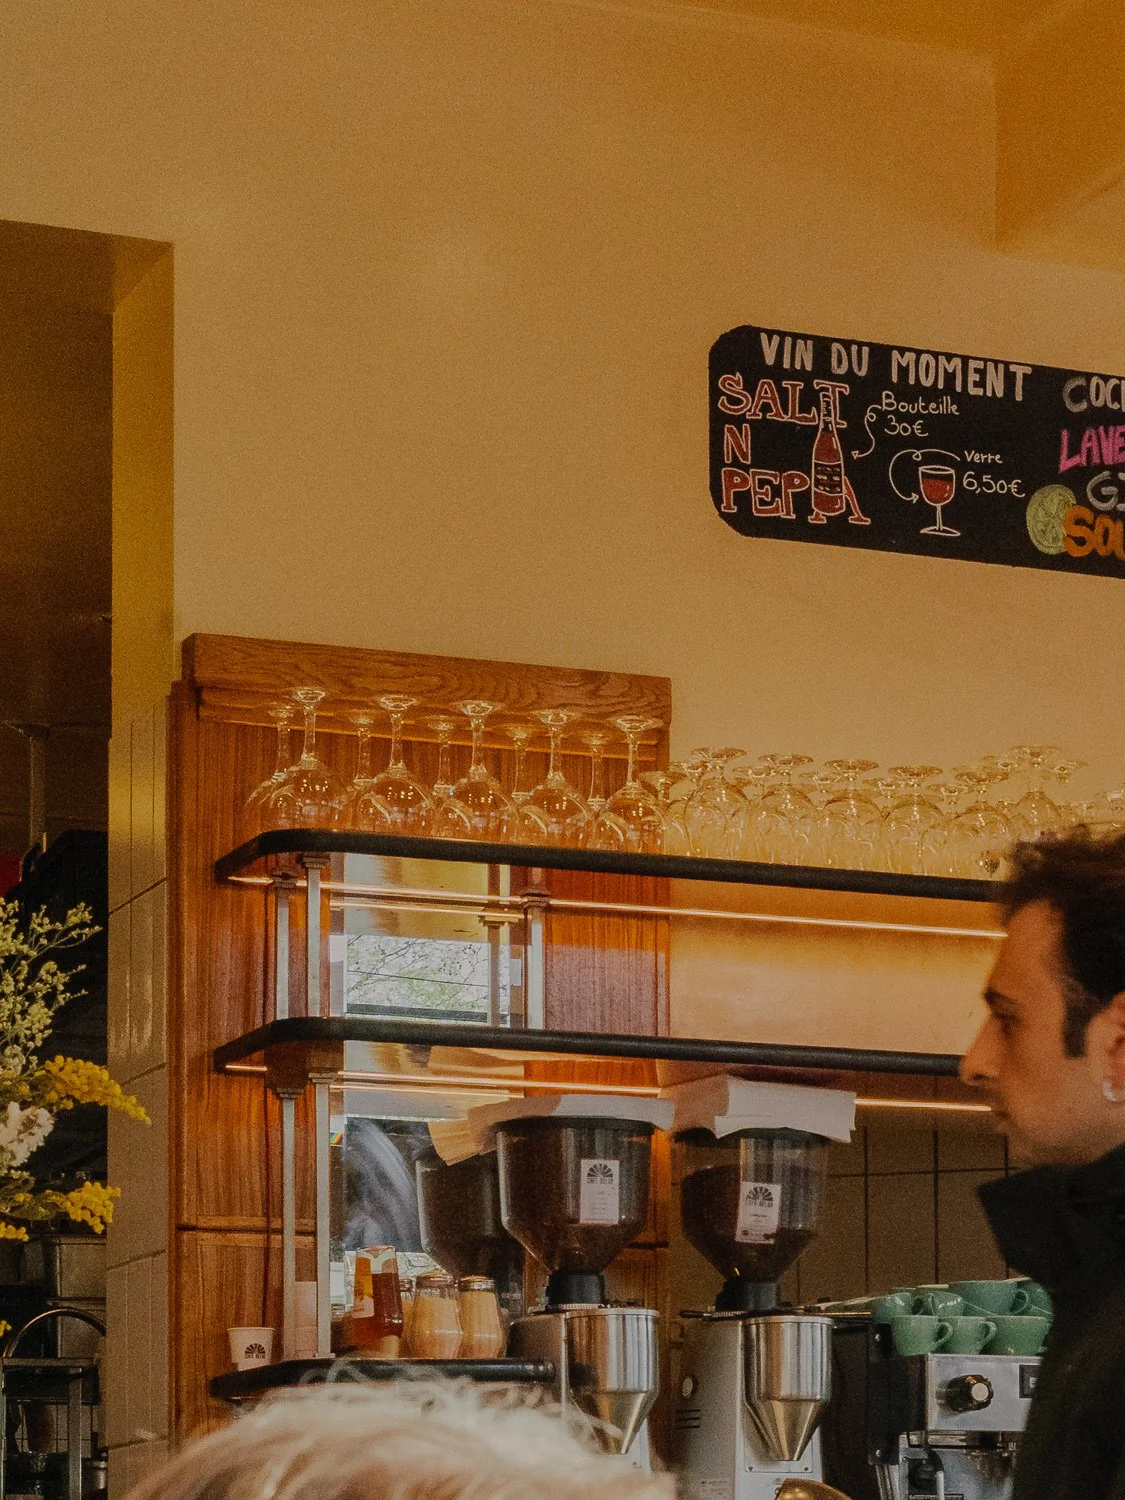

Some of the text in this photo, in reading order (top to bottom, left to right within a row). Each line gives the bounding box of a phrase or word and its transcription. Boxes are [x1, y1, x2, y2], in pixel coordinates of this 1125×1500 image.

[759, 332, 1032, 401] VIN DU MOMENT
[881, 391, 960, 415] Bouteille
[885, 416, 928, 436] 30€
[724, 424, 750, 464] N
[964, 451, 1002, 464] Verre
[963, 472, 1026, 497] 6,50€
